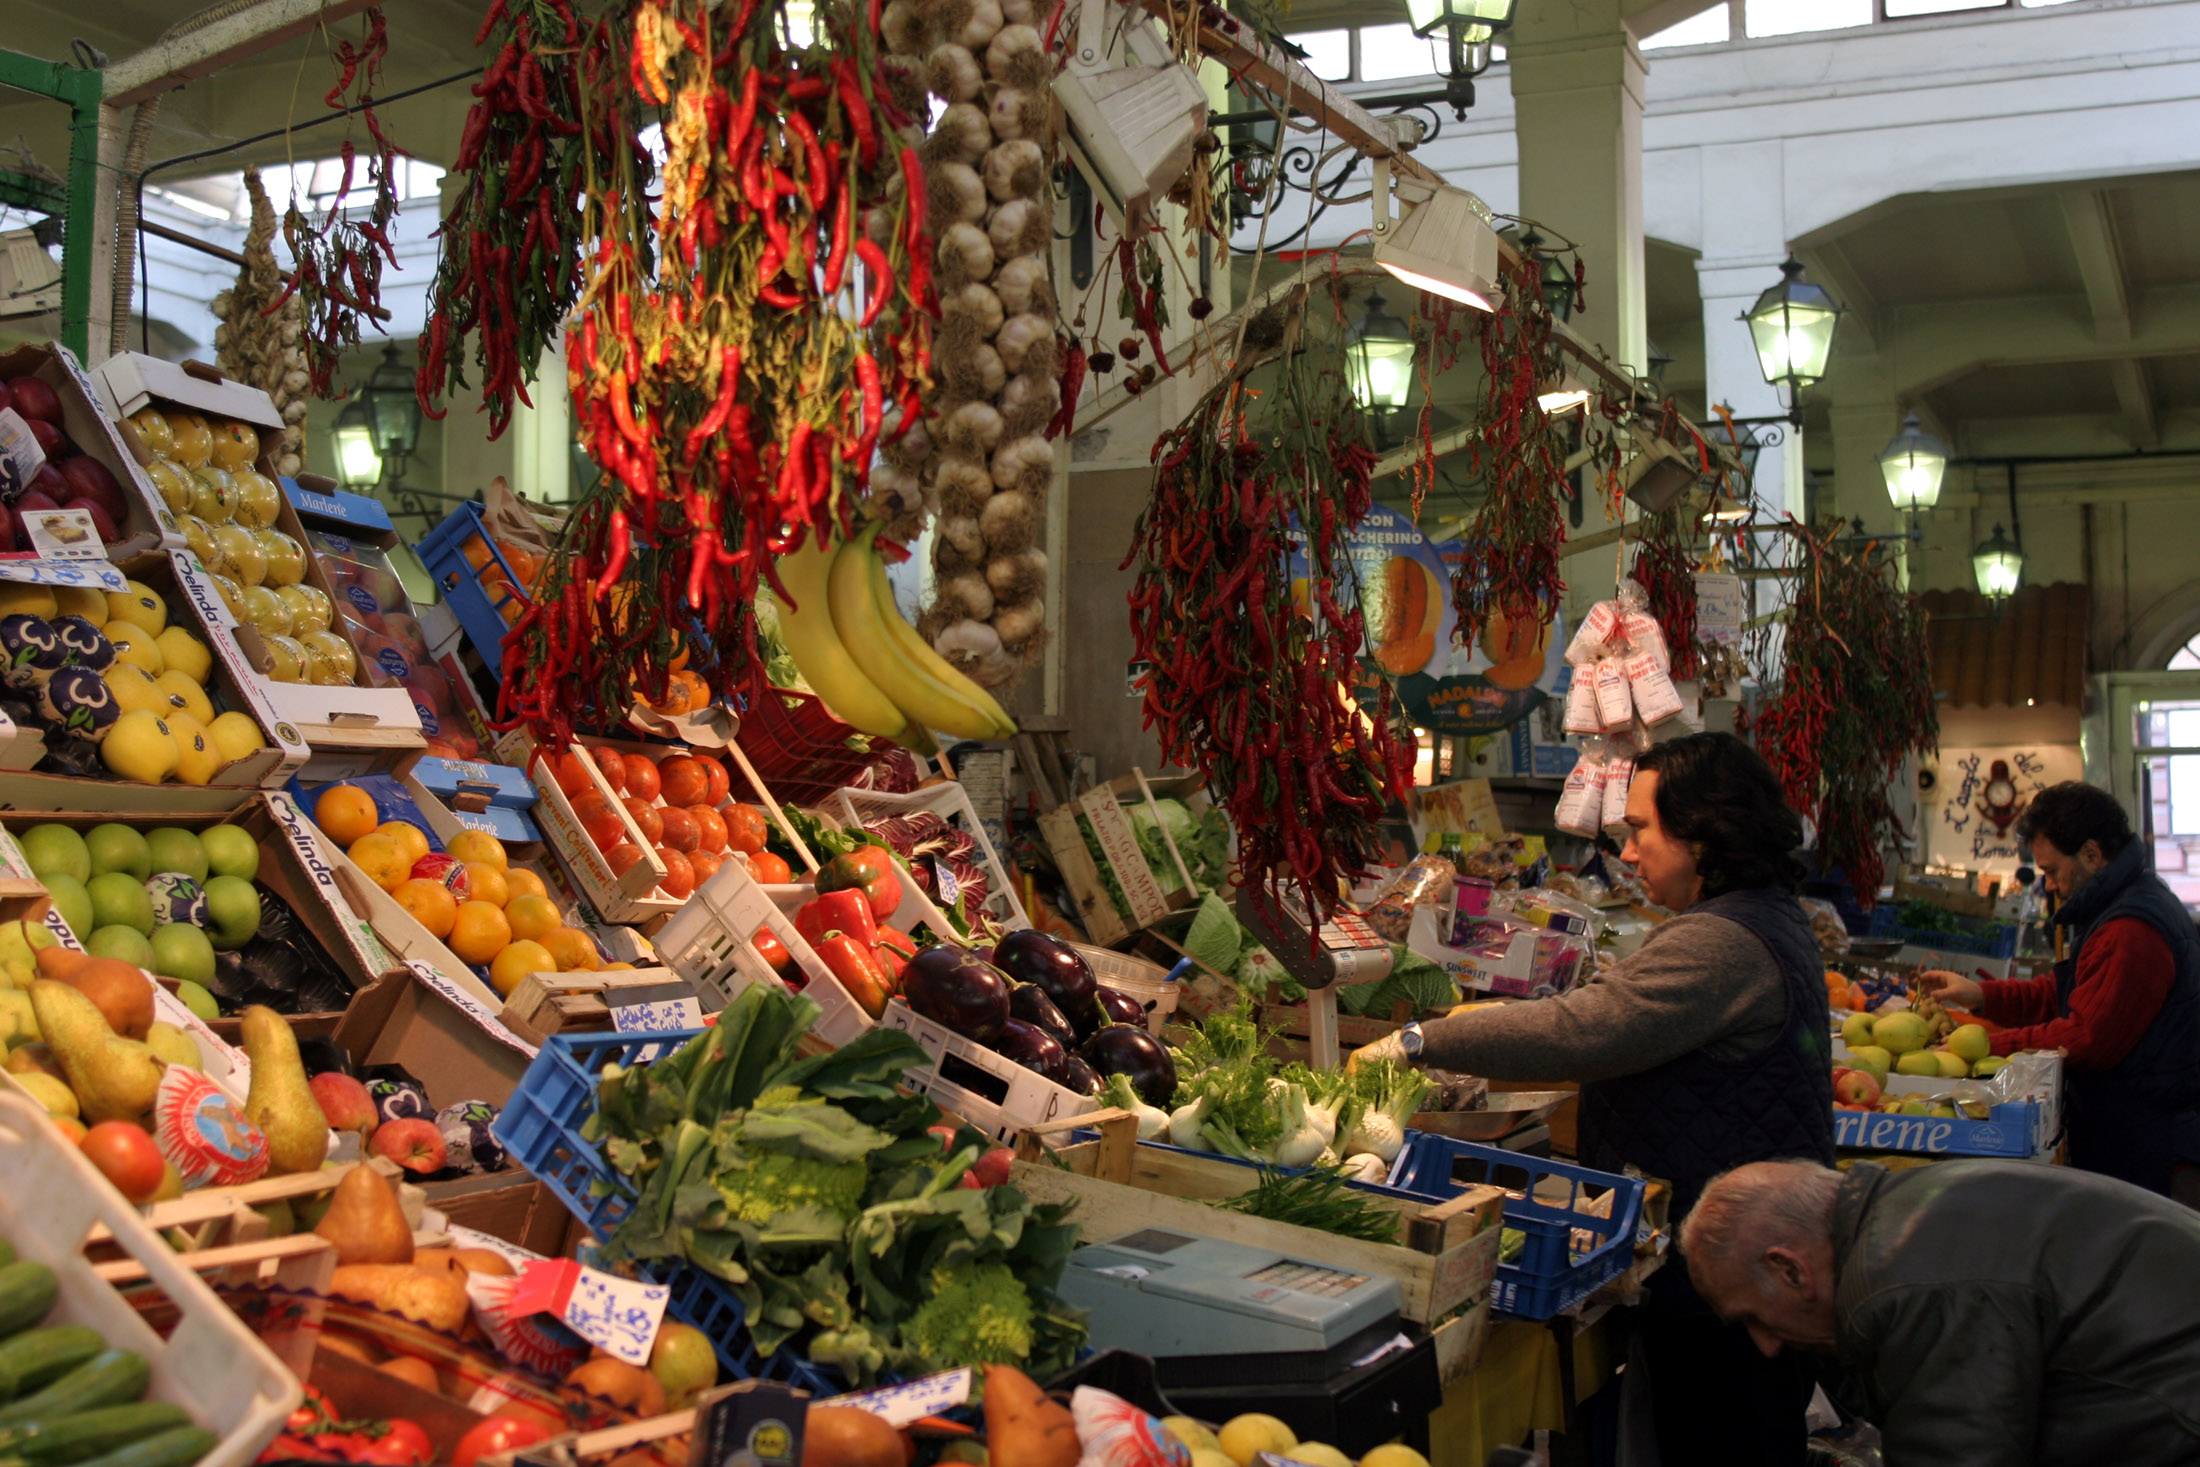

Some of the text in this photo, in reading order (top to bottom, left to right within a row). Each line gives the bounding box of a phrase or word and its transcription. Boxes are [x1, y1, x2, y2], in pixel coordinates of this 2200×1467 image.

[300, 492, 347, 518] Marlene
[1345, 532, 1423, 545] CCHERINO
[175, 553, 221, 623] Melinda
[271, 795, 333, 886] Melinda
[413, 963, 480, 1014] Melinda
[1446, 961, 1487, 981] SUNSWEET
[1836, 1112, 1952, 1152] rlene
